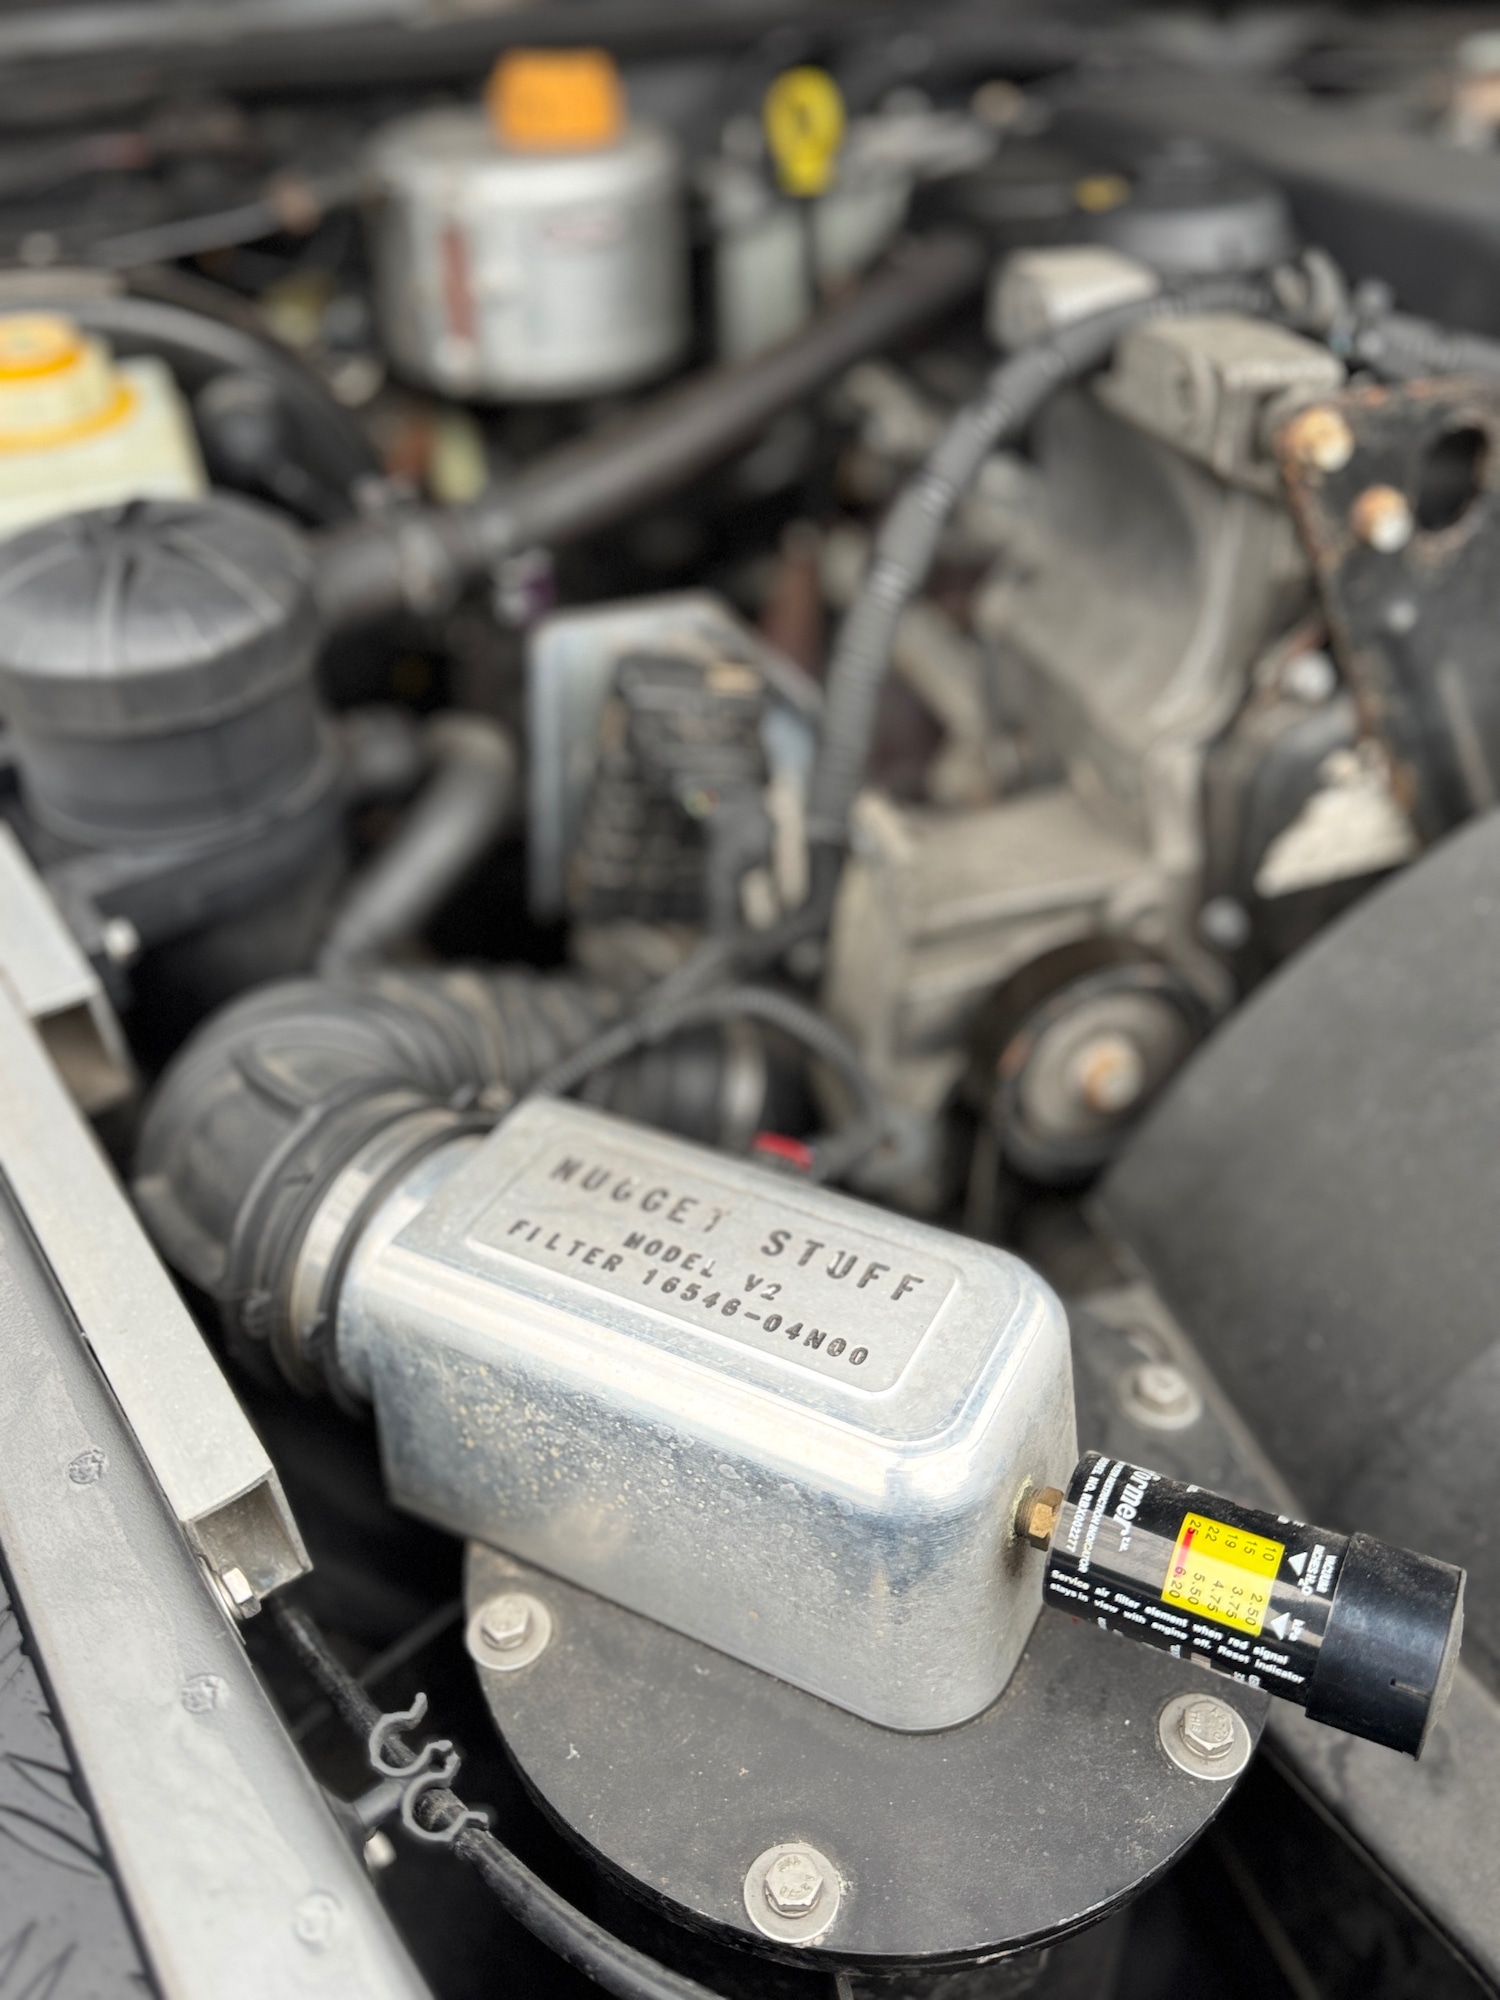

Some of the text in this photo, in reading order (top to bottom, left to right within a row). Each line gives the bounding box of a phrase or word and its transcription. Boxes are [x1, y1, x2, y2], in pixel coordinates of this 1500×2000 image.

[550, 1156, 924, 1302] NUGGET STUFF
[622, 1231, 782, 1302] MODEL V2
[507, 1219, 870, 1366] FILTER 16546-04N00
[1065, 1493, 1093, 1553] RBX002277
[1083, 1475, 1100, 1492] NO.
[1077, 1523, 1099, 1574] INDICATOR
[1168, 1519, 1202, 1599] 25 6.20
[1187, 1525, 1220, 1606] 22 5.50
[1206, 1533, 1239, 1613] 19 4.75
[1226, 1541, 1258, 1619] 15 3.75
[1244, 1547, 1278, 1626] 10 2.50
[1050, 1583, 1077, 1598] stays
[1077, 1591, 1089, 1602] in
[1094, 1599, 1119, 1614] view
[1122, 1610, 1147, 1625] with
[1151, 1621, 1189, 1640] engine
[1217, 1644, 1250, 1665] Reset
[1254, 1658, 1306, 1685] indicator
[1051, 1569, 1290, 1665] Service air filter element when red signal
